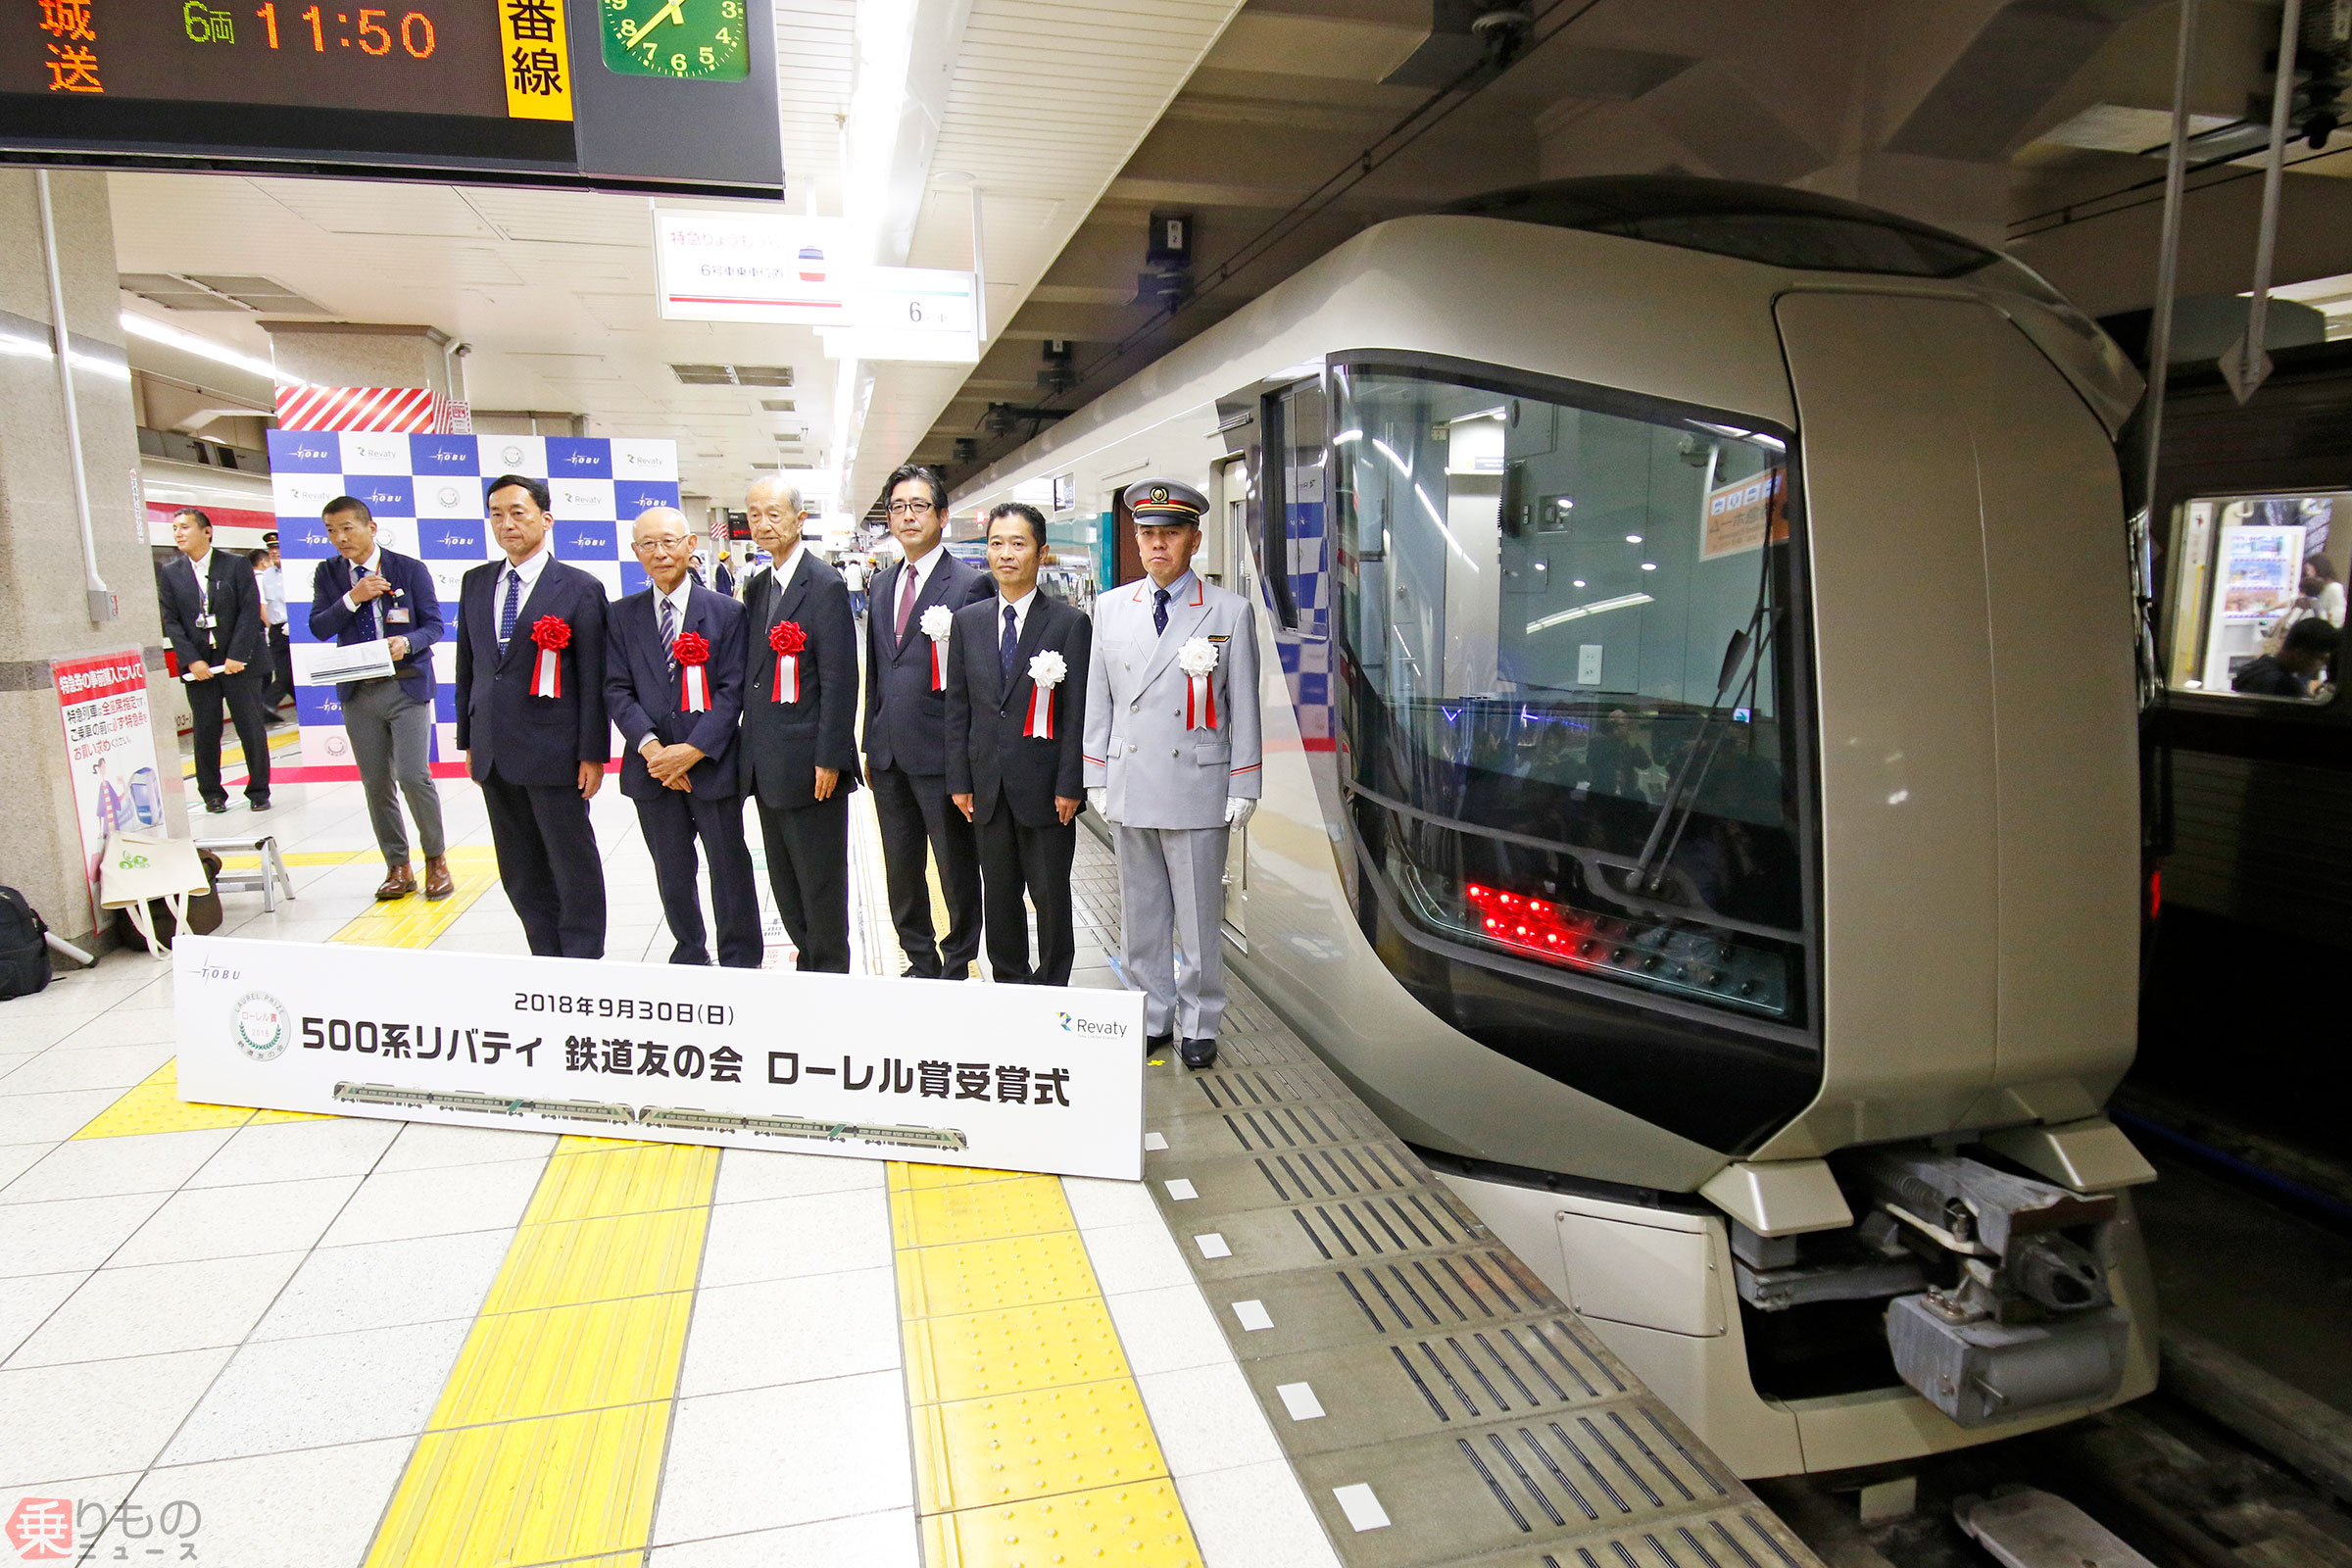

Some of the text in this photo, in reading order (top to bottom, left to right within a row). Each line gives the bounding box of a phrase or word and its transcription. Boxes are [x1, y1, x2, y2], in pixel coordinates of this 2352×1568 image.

[721, 1, 737, 19] 3
[256, 2, 436, 59] 11:50
[619, 19, 638, 36] 8
[714, 26, 732, 44] 4
[508, 0, 564, 96] 番線
[642, 42, 658, 61] 7
[698, 46, 715, 65] 5
[44, 43, 104, 93] 送
[670, 54, 688, 72] 6
[295, 448, 328, 460] TOBU
[434, 450, 466, 463] TOBU
[569, 454, 601, 466] TOBU
[369, 492, 402, 503] TOBU
[442, 535, 474, 546] TOBU
[576, 537, 607, 548] TOBU
[199, 965, 241, 981] TOBU
[235, 993, 260, 1013] LAUREL
[514, 993, 735, 1027] 2018年9月30日(日)
[1076, 1018, 1128, 1038] Revaty
[301, 1016, 1071, 1107] 500系リバティ 鉄道友の会 ローレル賞受賞式
